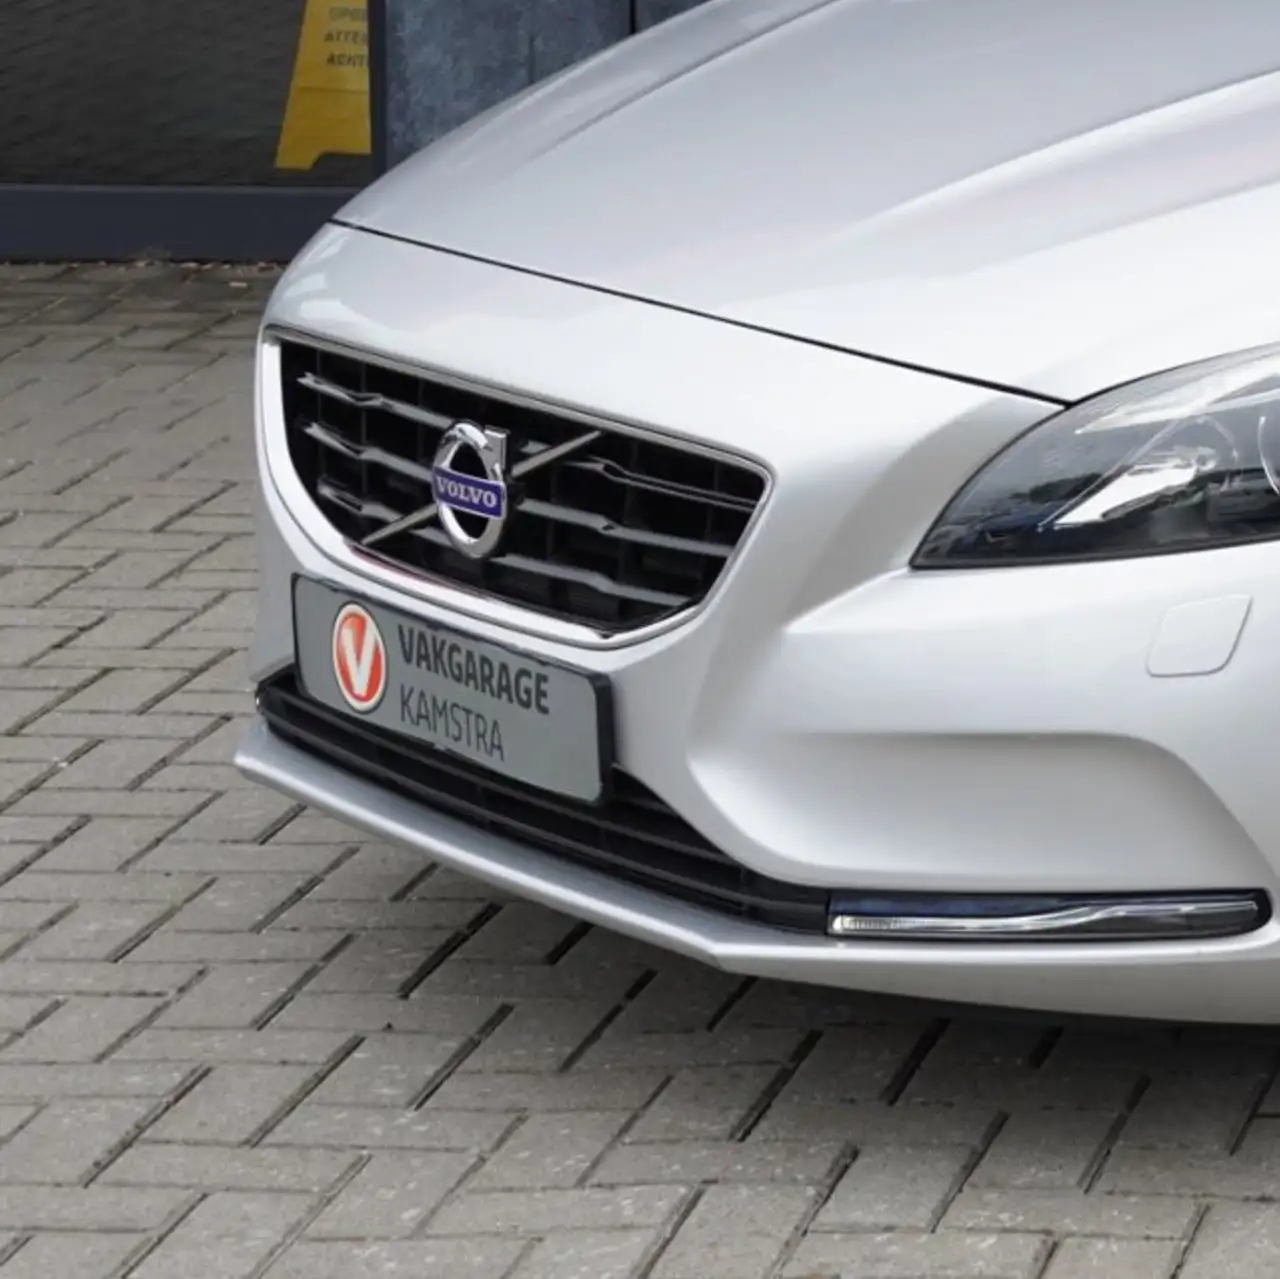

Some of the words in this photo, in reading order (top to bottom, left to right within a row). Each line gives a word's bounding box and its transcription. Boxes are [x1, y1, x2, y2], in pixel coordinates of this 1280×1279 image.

[436, 476, 498, 508] VOLVO
[397, 624, 550, 715] VAKGARAGE
[399, 683, 505, 763] KAMSTRA
